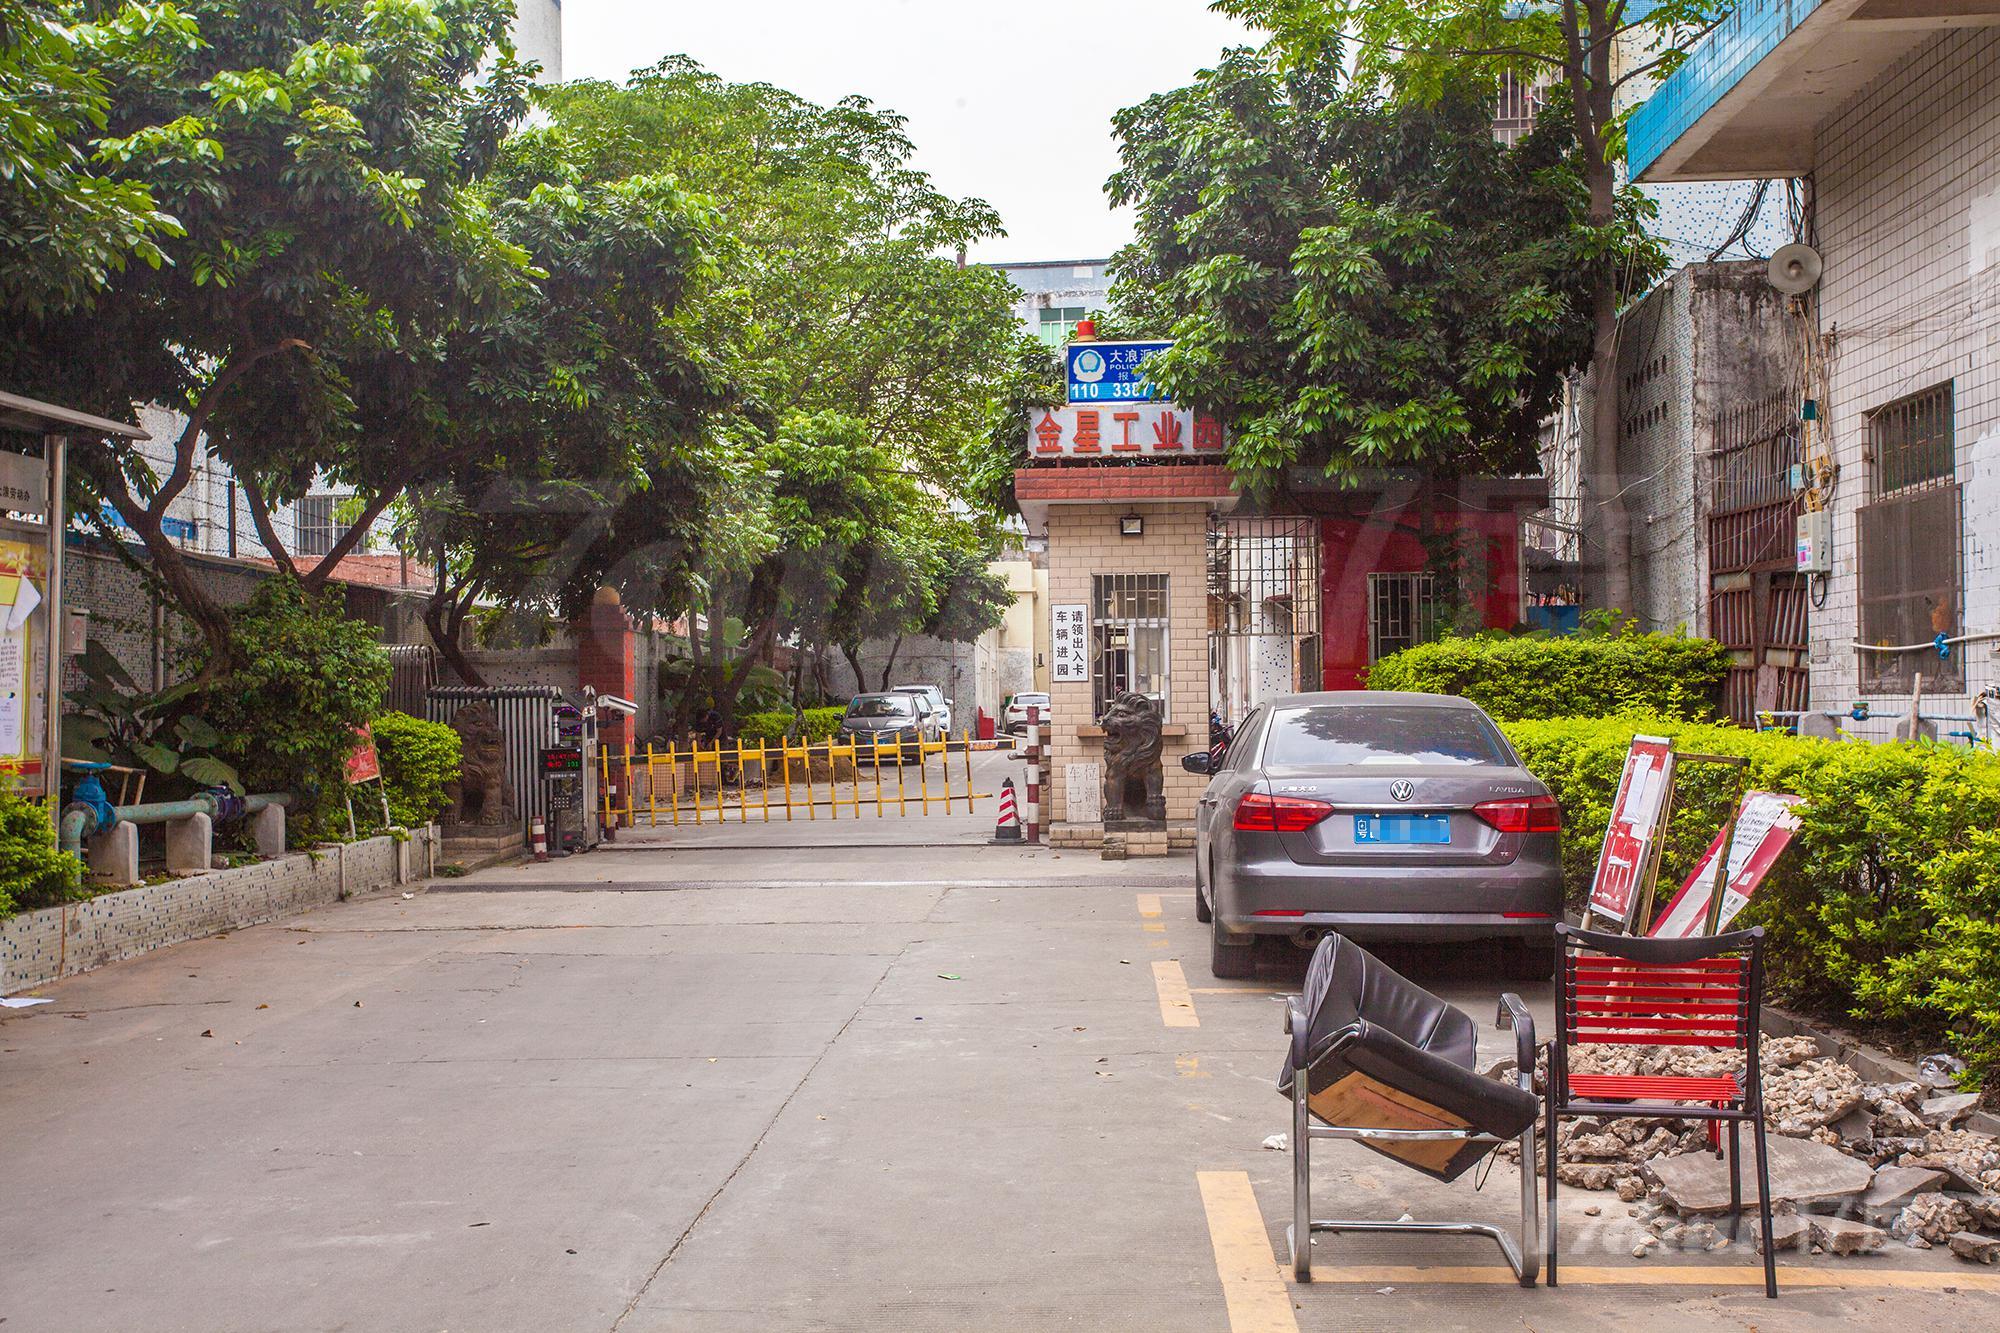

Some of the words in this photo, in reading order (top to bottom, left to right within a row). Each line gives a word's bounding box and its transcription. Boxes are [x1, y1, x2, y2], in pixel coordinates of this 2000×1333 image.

[1071, 383, 1099, 398] 110
[1035, 410, 1223, 453] 金星工业园
[1056, 610, 1069, 676] 车辆进园
[1071, 610, 1084, 676] 请领出入卡
[1488, 785, 1525, 794] LAVIDA
